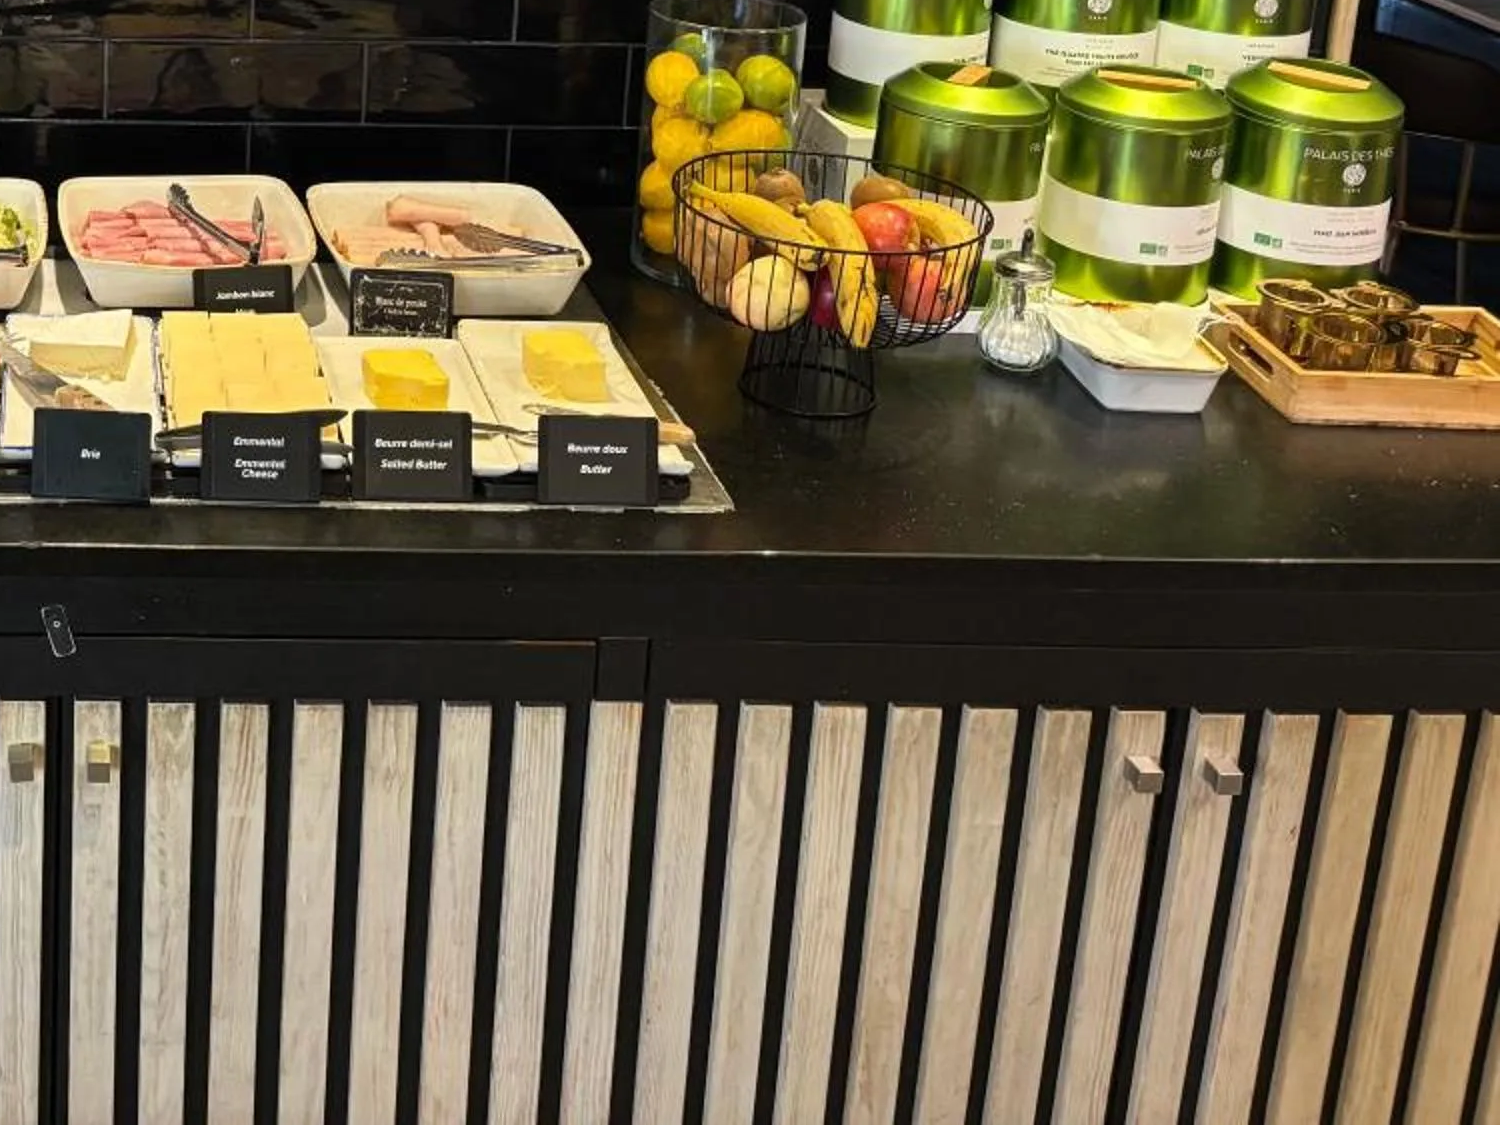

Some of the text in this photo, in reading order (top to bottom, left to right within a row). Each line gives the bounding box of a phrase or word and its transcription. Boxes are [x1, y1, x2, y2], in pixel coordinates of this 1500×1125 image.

[1303, 146, 1349, 162] PALAIS
[233, 436, 285, 448] Emmental
[374, 437, 408, 449] Beurre
[80, 447, 101, 460] Brie
[567, 442, 629, 455] Beurre doux
[234, 458, 287, 469] Emmental
[415, 458, 448, 471] Butter
[579, 463, 612, 475] Butter
